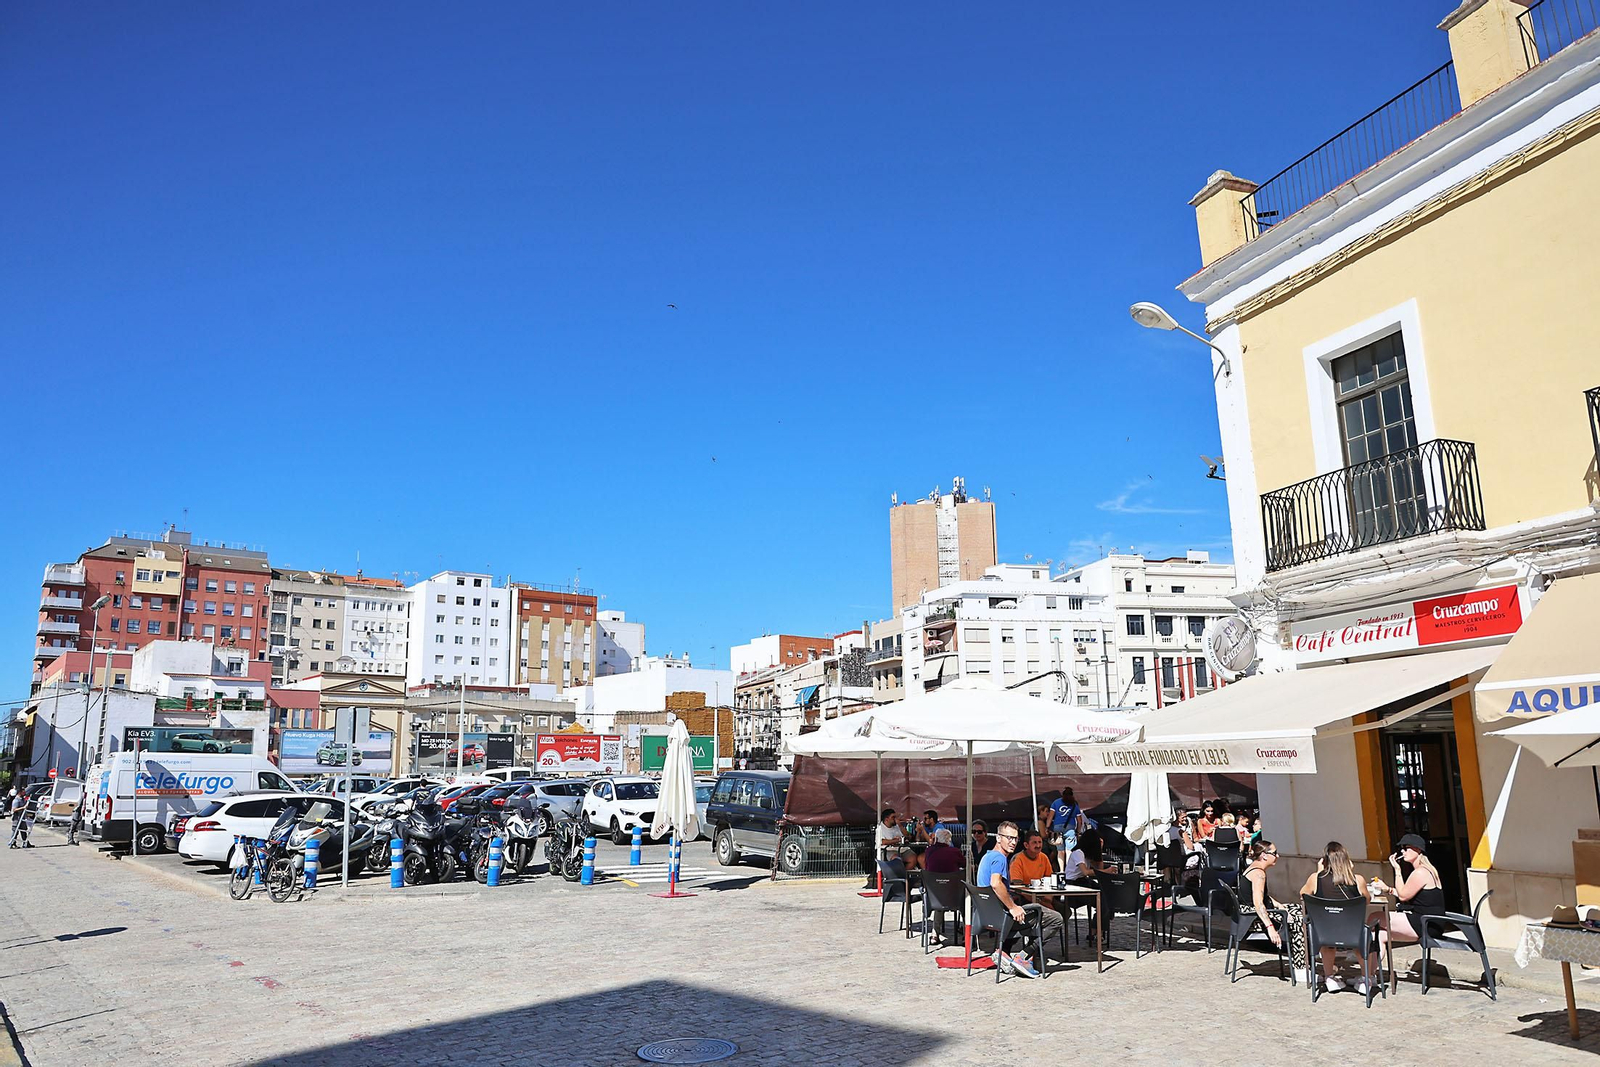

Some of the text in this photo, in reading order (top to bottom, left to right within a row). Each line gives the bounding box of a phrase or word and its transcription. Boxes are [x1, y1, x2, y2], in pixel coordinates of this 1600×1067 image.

[1433, 599, 1498, 619] Cruzcampo
[1356, 616, 1381, 627] Fundado
[1390, 612, 1404, 620] 1913
[1435, 613, 1506, 628] MAESTROS CERVECEROS
[1296, 617, 1413, 653] Café Central
[1077, 724, 1131, 737] Cruzcampo
[1102, 748, 1230, 766] LA CENTRAL FUNDADO EN 1913
[1256, 748, 1297, 759] Cruzcampo
[136, 772, 234, 795] telefurgo
